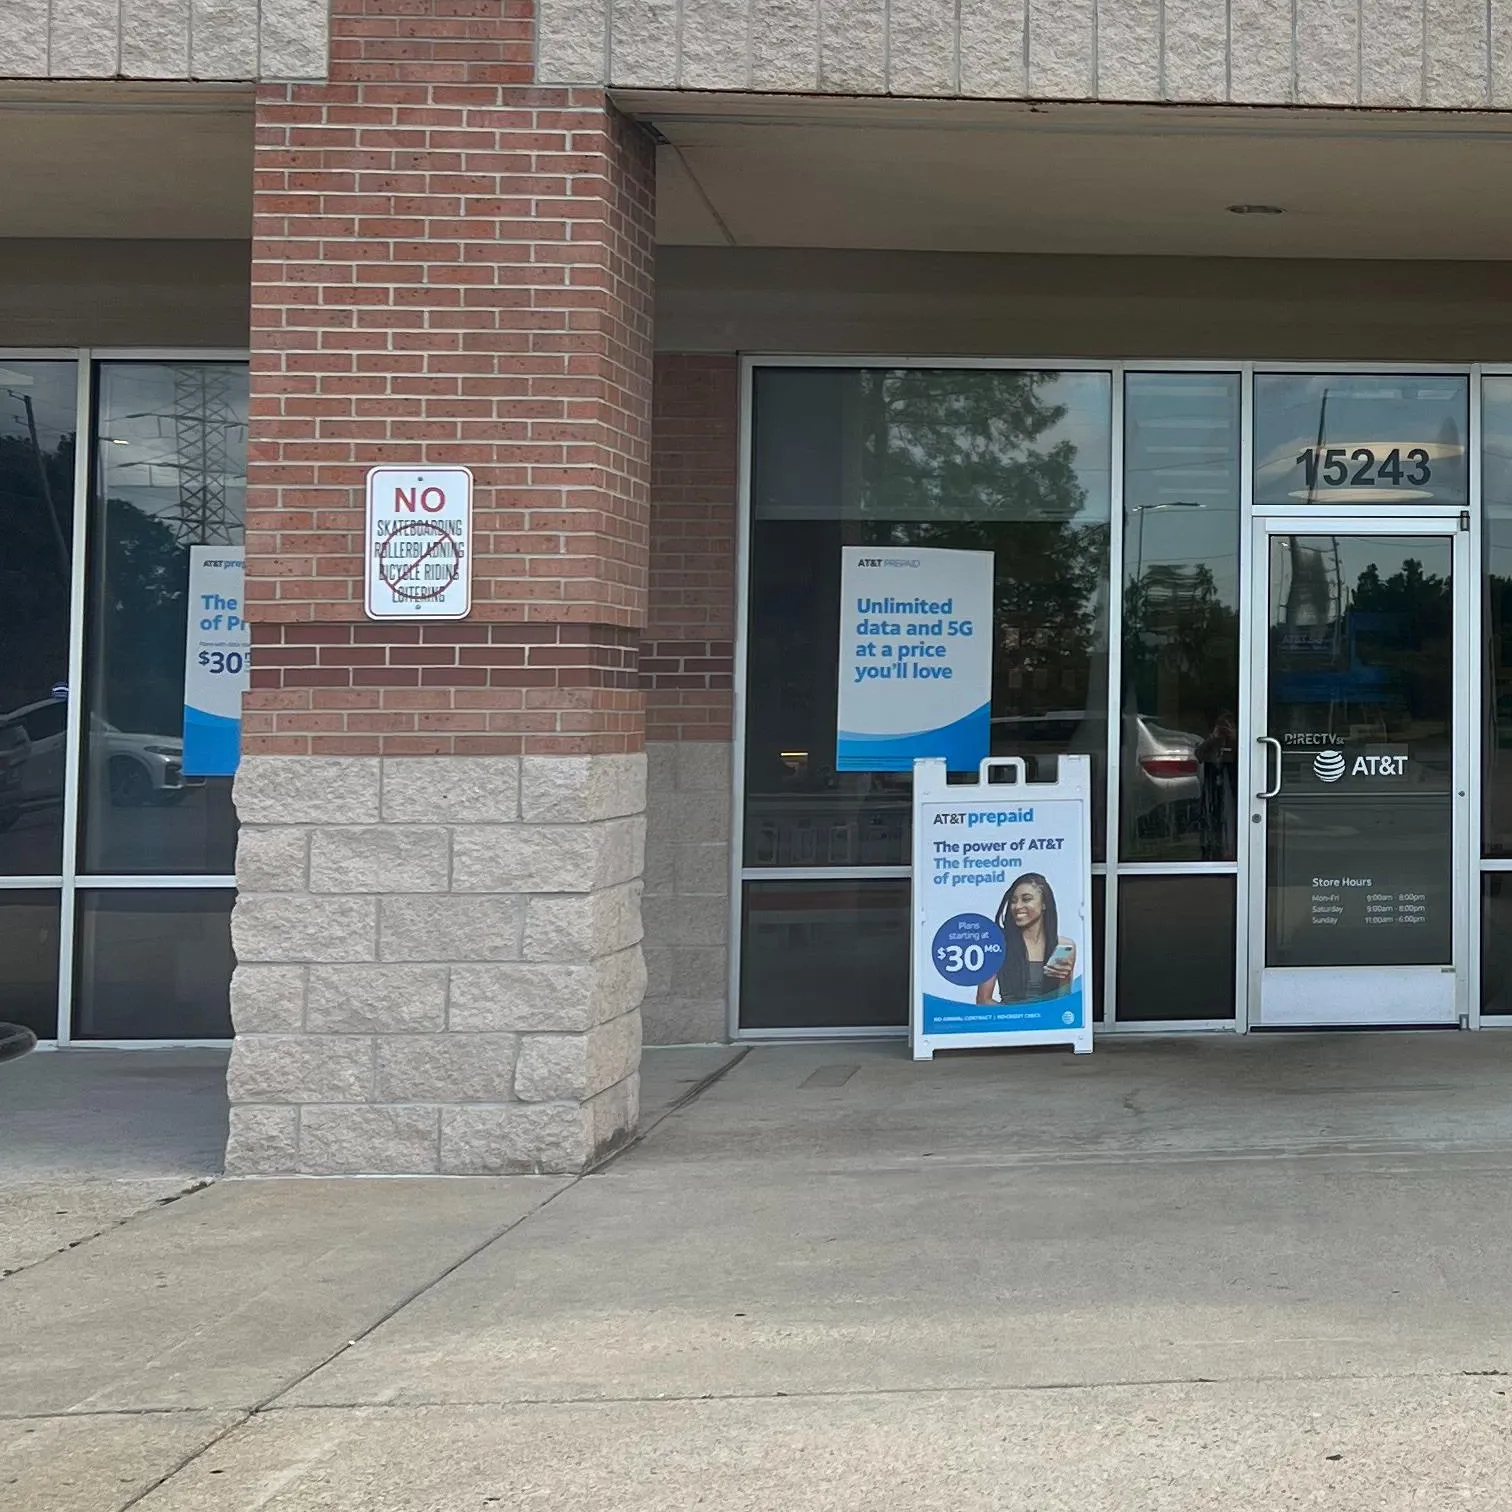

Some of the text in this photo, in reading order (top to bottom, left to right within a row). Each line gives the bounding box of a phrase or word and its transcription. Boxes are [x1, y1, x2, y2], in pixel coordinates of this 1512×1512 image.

[1296, 448, 1431, 486] 15243
[394, 487, 445, 513] NO
[377, 519, 462, 536] SKATEBOARDING
[857, 559, 920, 568] AT&T PREPAID
[379, 564, 459, 581] BICYCLE RIDING
[201, 594, 237, 610] The
[392, 586, 445, 603] LOITERING
[857, 597, 953, 615] Unlimited
[200, 615, 222, 631] of
[856, 619, 973, 636] data and 5G
[856, 641, 947, 661] at a price
[198, 650, 243, 674] $30
[854, 662, 953, 683] you'll love
[1351, 755, 1408, 776] AT&T
[933, 808, 1034, 827] AT&T prepaid
[933, 838, 1064, 855] The power of AT&T
[933, 856, 1022, 869] The freedom
[933, 870, 1005, 887] of prepaid
[1312, 877, 1372, 887] Store Hours
[958, 921, 980, 930] Plans
[948, 931, 989, 941] starting at
[937, 944, 1002, 972] $30 MO.
